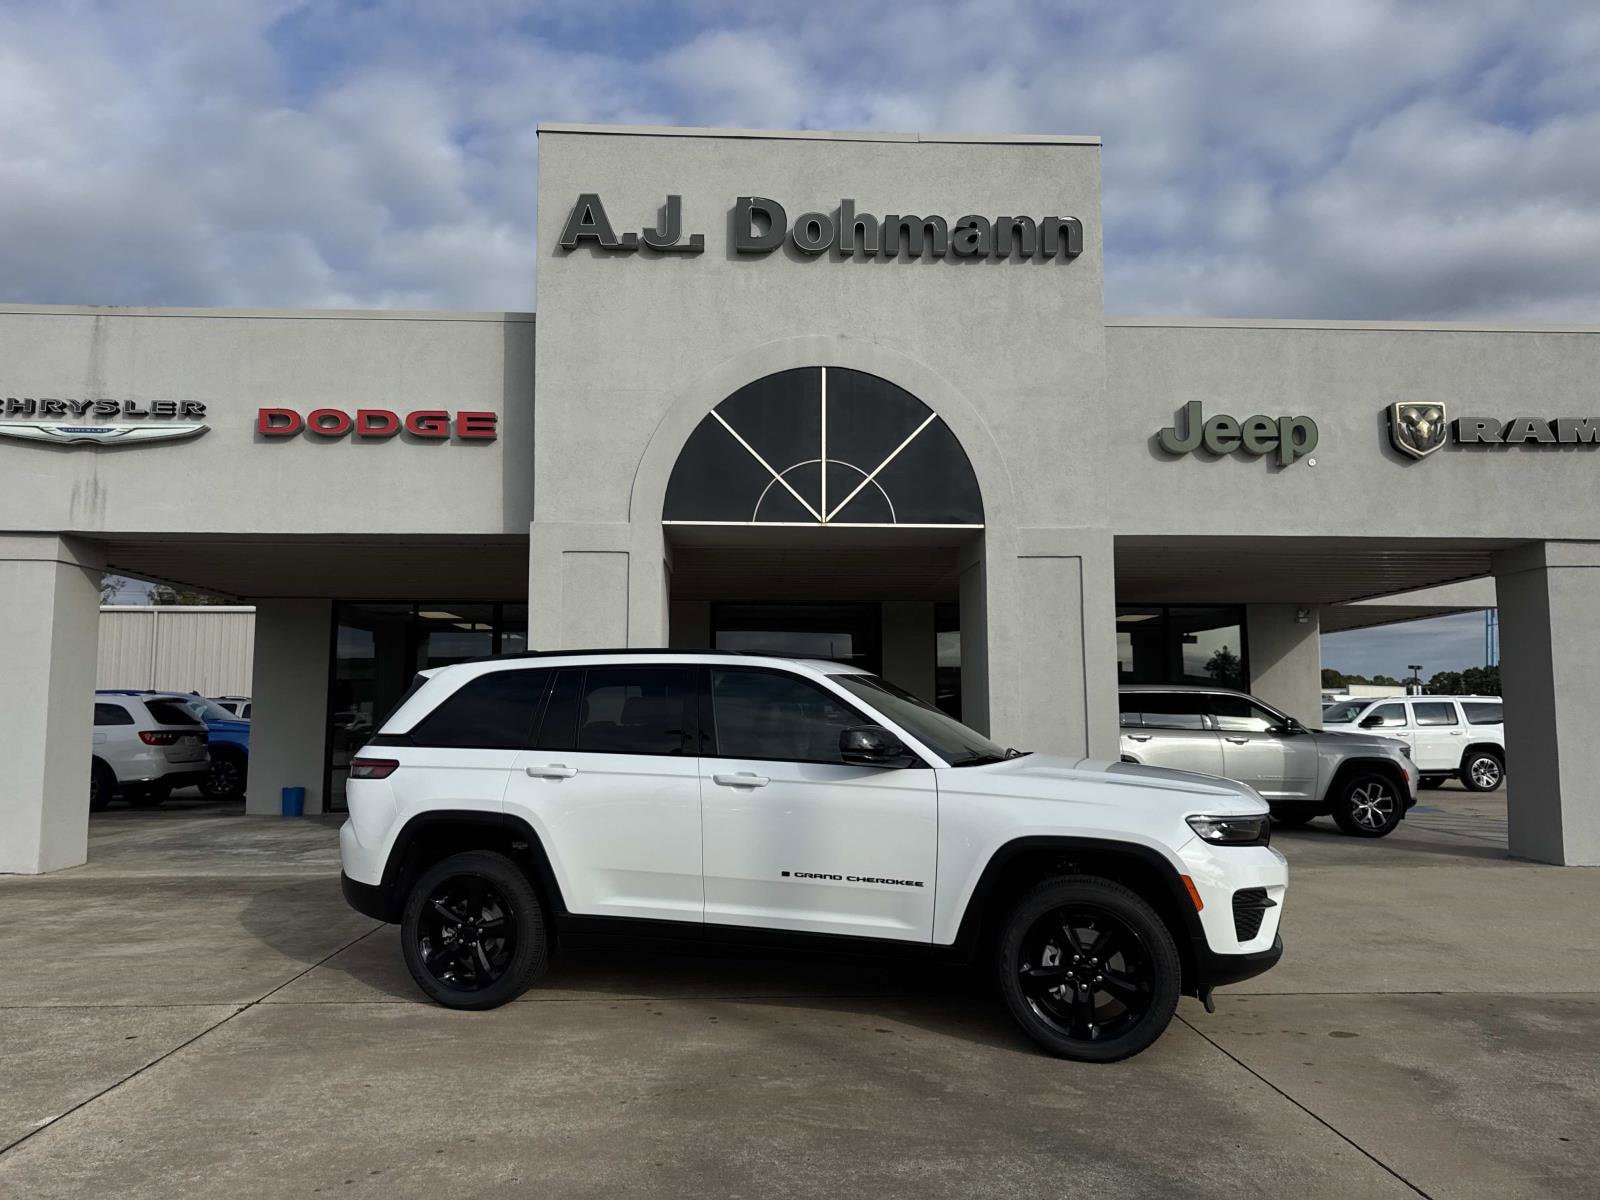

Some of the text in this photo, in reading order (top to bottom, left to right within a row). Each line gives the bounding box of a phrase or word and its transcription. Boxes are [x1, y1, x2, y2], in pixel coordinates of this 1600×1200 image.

[560, 193, 1083, 257] A.J. Dohmann
[0, 398, 206, 416] HRYSLER
[257, 408, 498, 441] DODGE
[1159, 400, 1318, 467] Jeep
[1456, 416, 1600, 443] RAM
[794, 872, 924, 887] GRAND CHEROKEE
